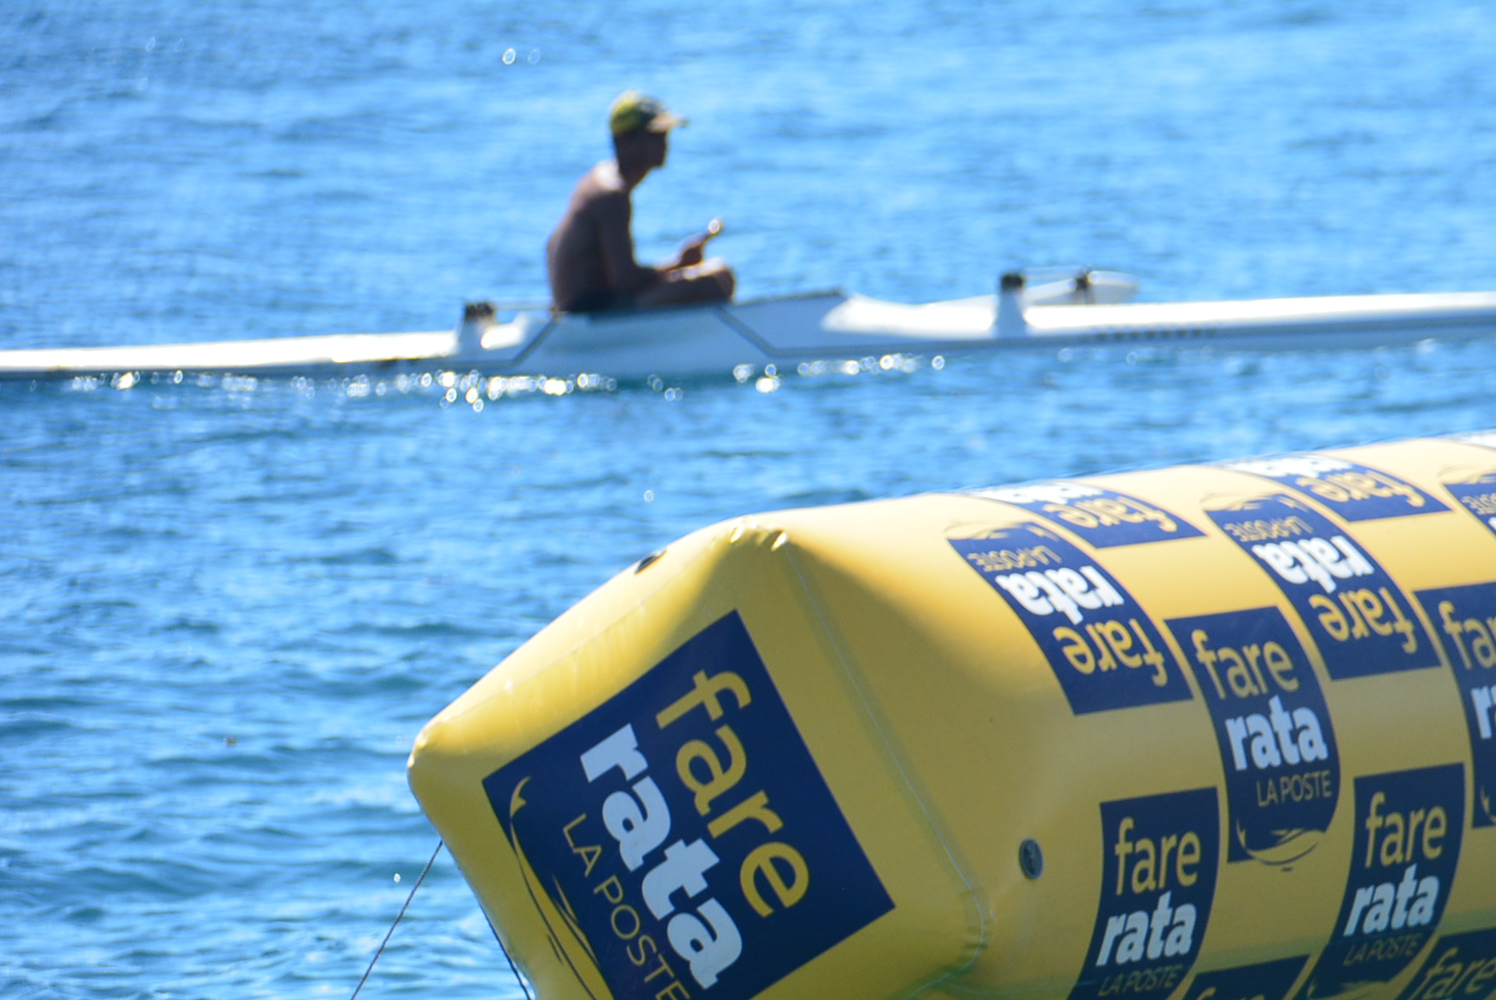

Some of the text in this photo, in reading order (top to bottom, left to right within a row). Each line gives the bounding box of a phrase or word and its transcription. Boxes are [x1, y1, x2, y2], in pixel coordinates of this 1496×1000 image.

[995, 566, 1124, 625] rata
[1251, 535, 1375, 594] rata
[1053, 619, 1168, 687] fare
[1309, 587, 1420, 654] fare
[1191, 629, 1300, 699] fare
[1225, 695, 1328, 771] rata
[656, 669, 809, 918] fare
[1256, 770, 1333, 807] LA POSTE
[562, 813, 603, 878] LA
[580, 723, 743, 990] rata
[1114, 817, 1201, 896] fare
[1365, 791, 1446, 868] fare
[1096, 890, 1197, 967] rata
[1343, 863, 1441, 937] rata
[1098, 964, 1183, 996] LA POSTE
